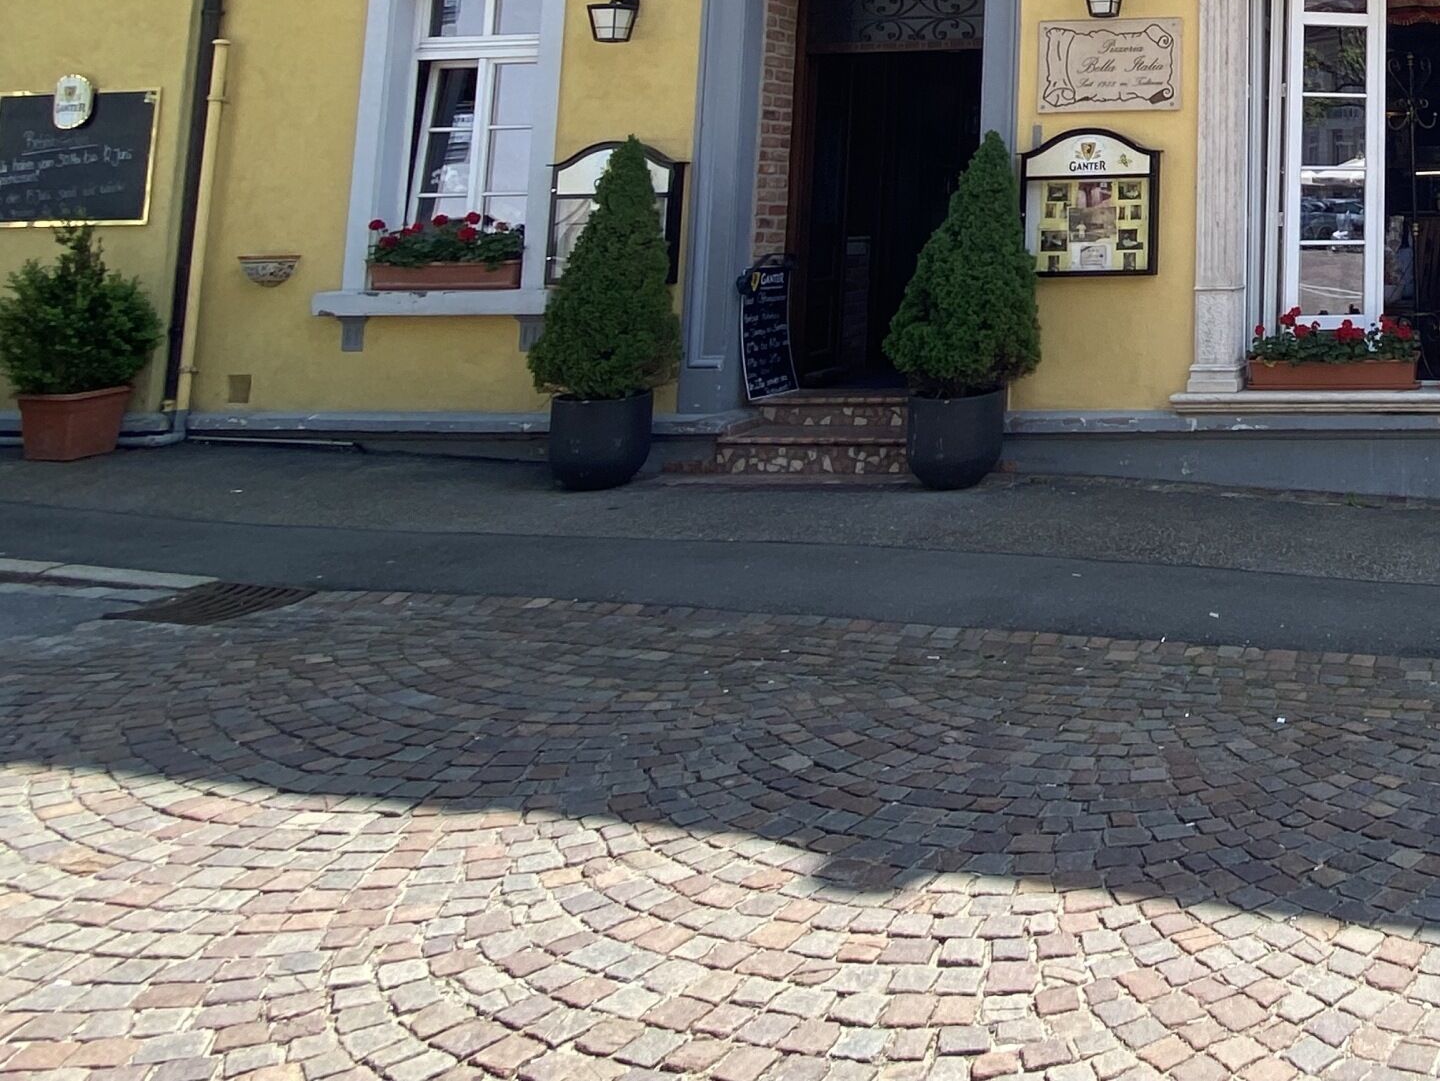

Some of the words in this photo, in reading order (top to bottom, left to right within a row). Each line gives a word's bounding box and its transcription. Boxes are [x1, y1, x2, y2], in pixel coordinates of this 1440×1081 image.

[1097, 39, 1144, 54] Pizzeria
[1077, 56, 1116, 74] Bella
[1124, 55, 1164, 72] Italia
[1069, 160, 1106, 171] GANTER
